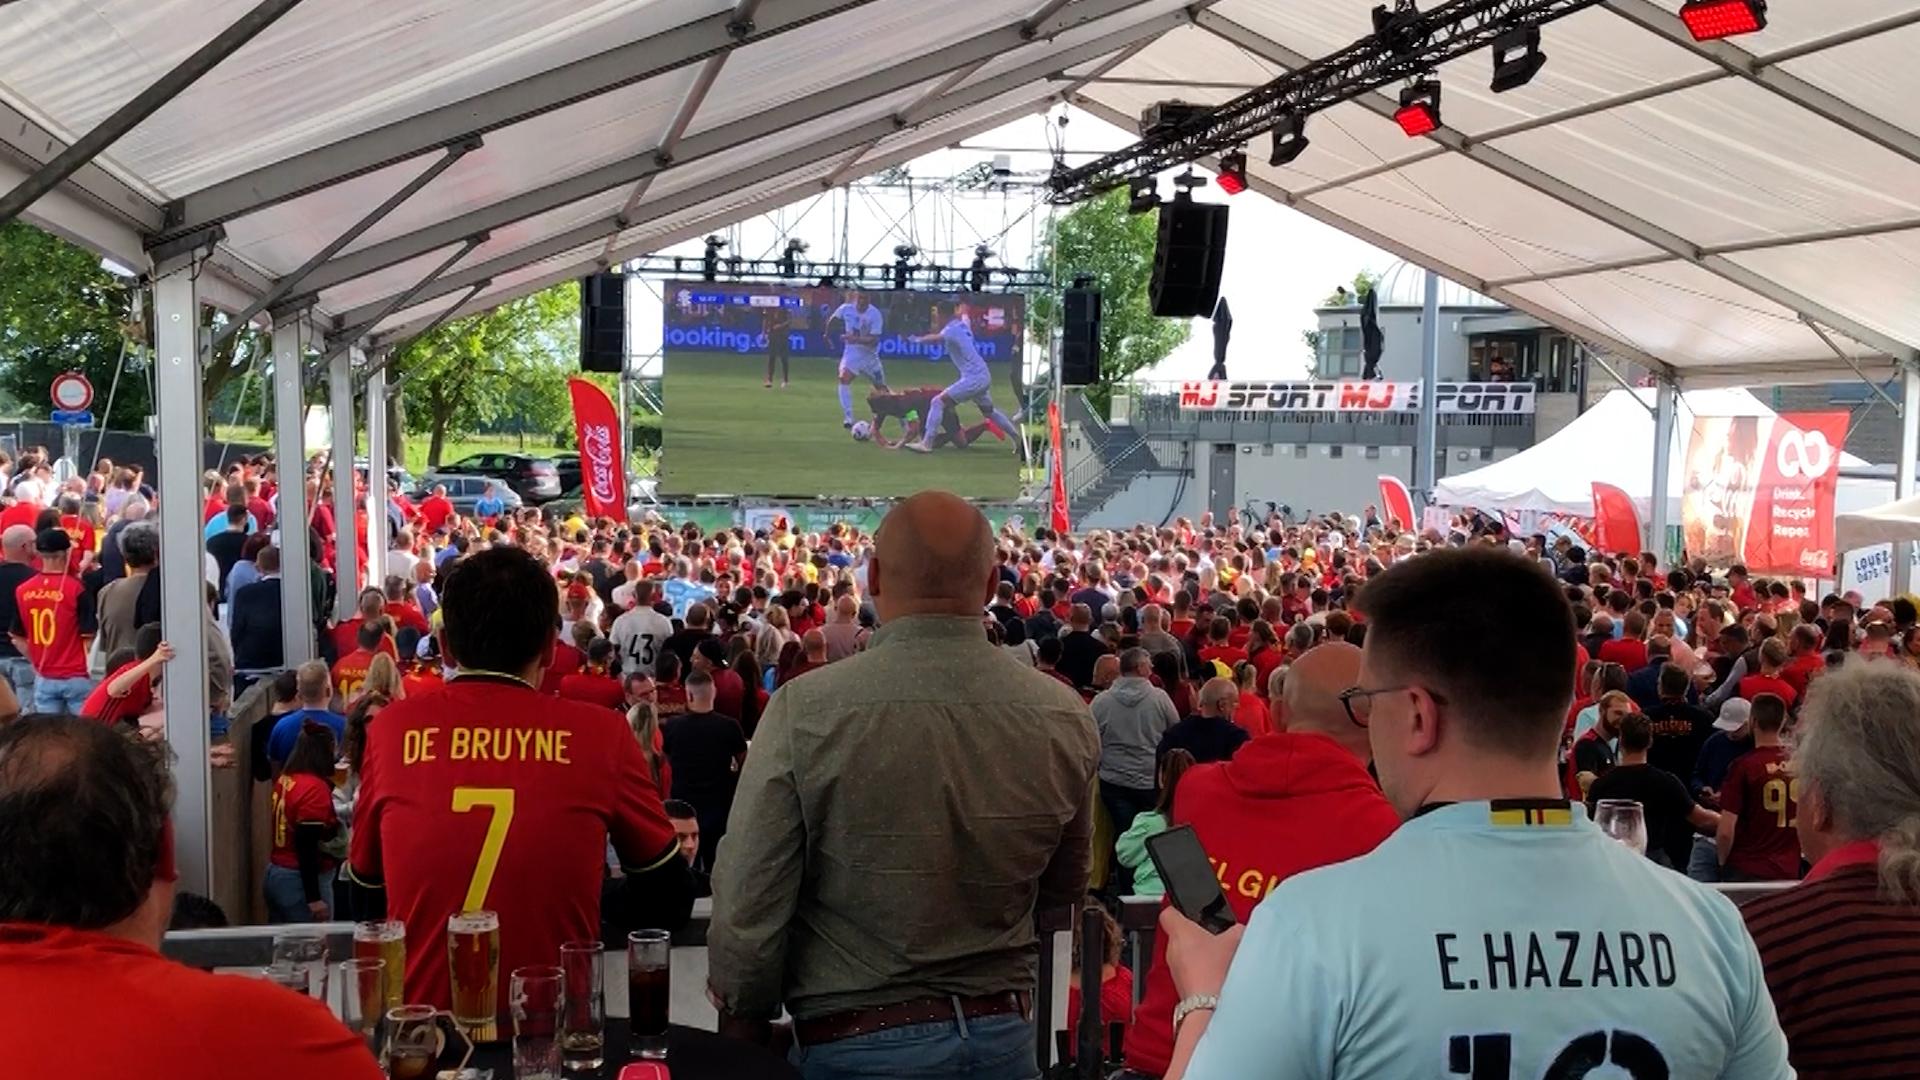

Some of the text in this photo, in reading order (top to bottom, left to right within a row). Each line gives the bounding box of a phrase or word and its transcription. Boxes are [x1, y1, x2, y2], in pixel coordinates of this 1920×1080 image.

[1181, 383, 1218, 406] MJ
[1227, 385, 1334, 408] SPORT
[1341, 385, 1395, 409] MJ
[30, 608, 55, 646] 10
[629, 634, 654, 665] 43
[403, 727, 572, 766] DE BRUYNE
[452, 787, 515, 912] 7
[1435, 930, 1677, 990] E.HAZARD
